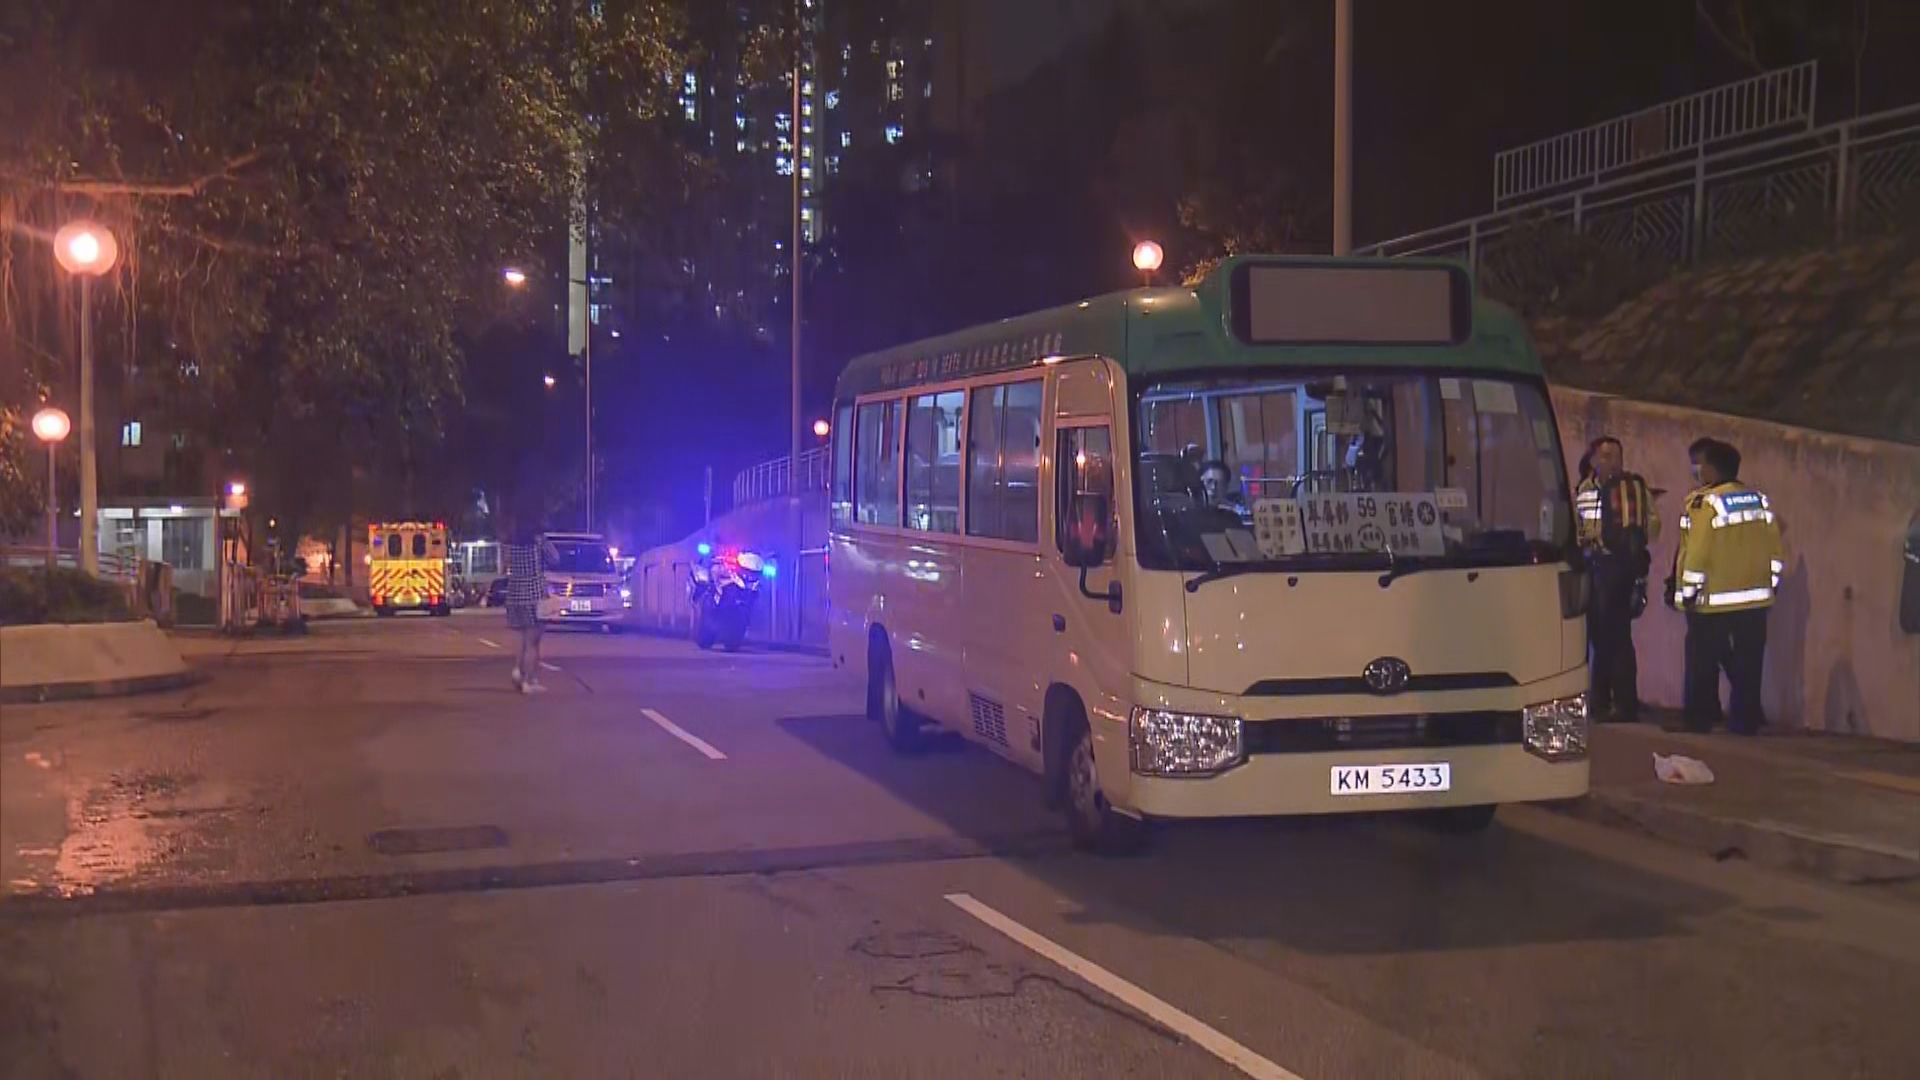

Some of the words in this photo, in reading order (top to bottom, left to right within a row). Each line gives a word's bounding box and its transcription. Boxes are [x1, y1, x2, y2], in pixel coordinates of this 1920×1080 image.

[1357, 497, 1377, 518] 59
[1338, 769, 1369, 791] KM
[1381, 767, 1442, 789] 5433
